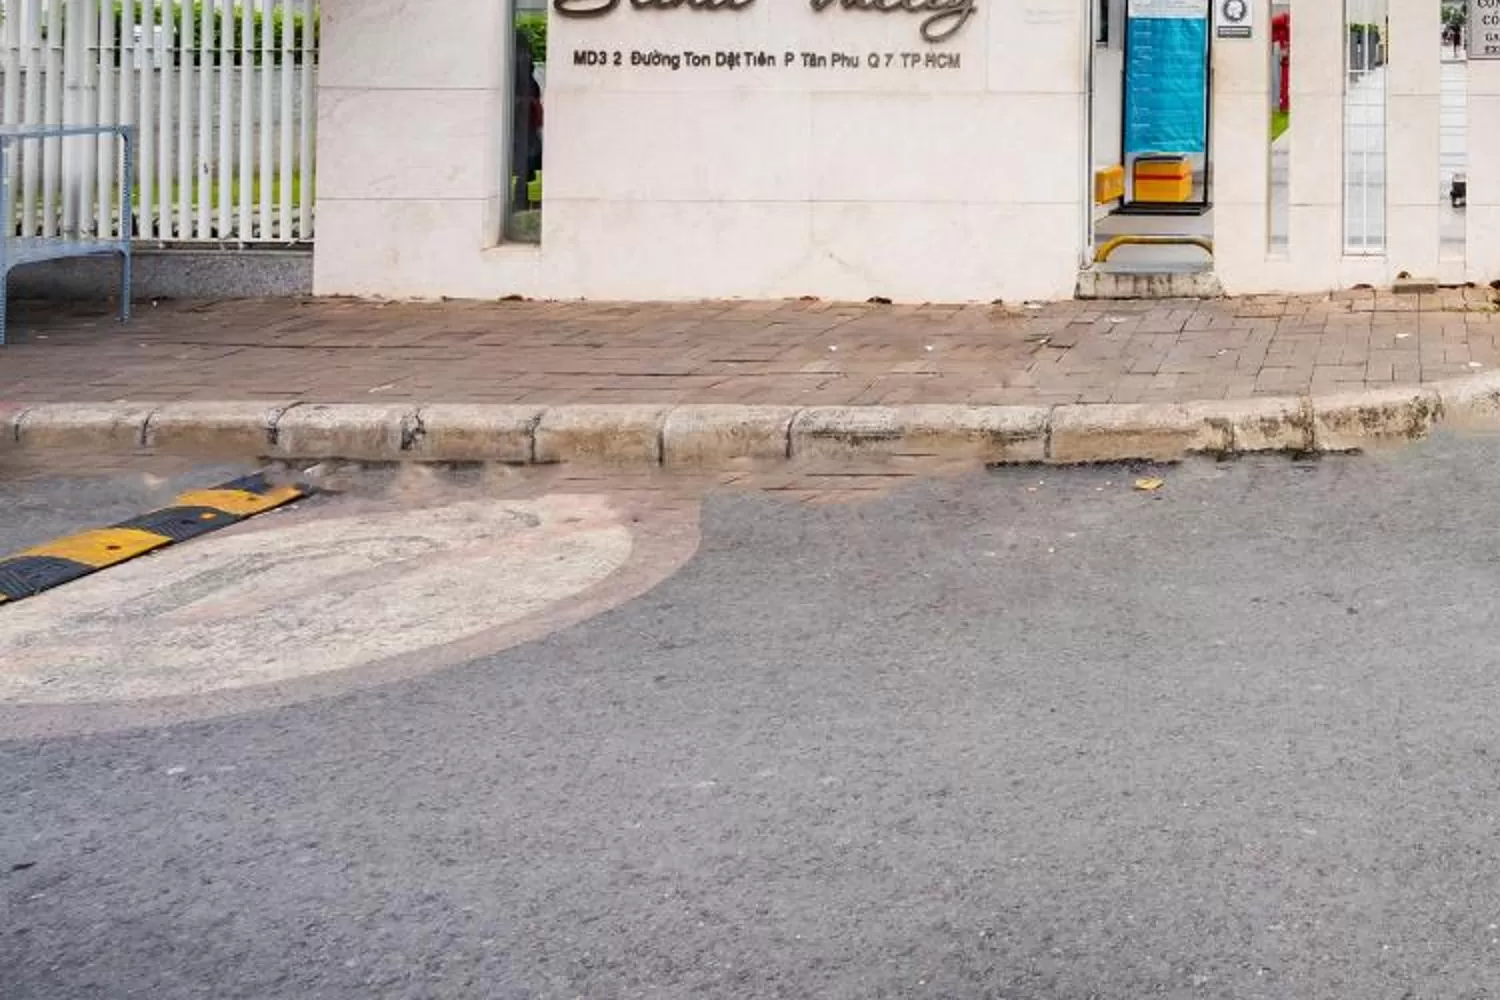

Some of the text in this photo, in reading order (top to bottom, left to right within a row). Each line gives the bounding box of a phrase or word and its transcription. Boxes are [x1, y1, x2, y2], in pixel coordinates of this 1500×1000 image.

[573, 50, 607, 66] MD3
[613, 50, 622, 66] 2
[631, 49, 680, 70] Đường
[784, 51, 795, 67] P
[867, 52, 880, 68] Q
[884, 53, 894, 67] 7
